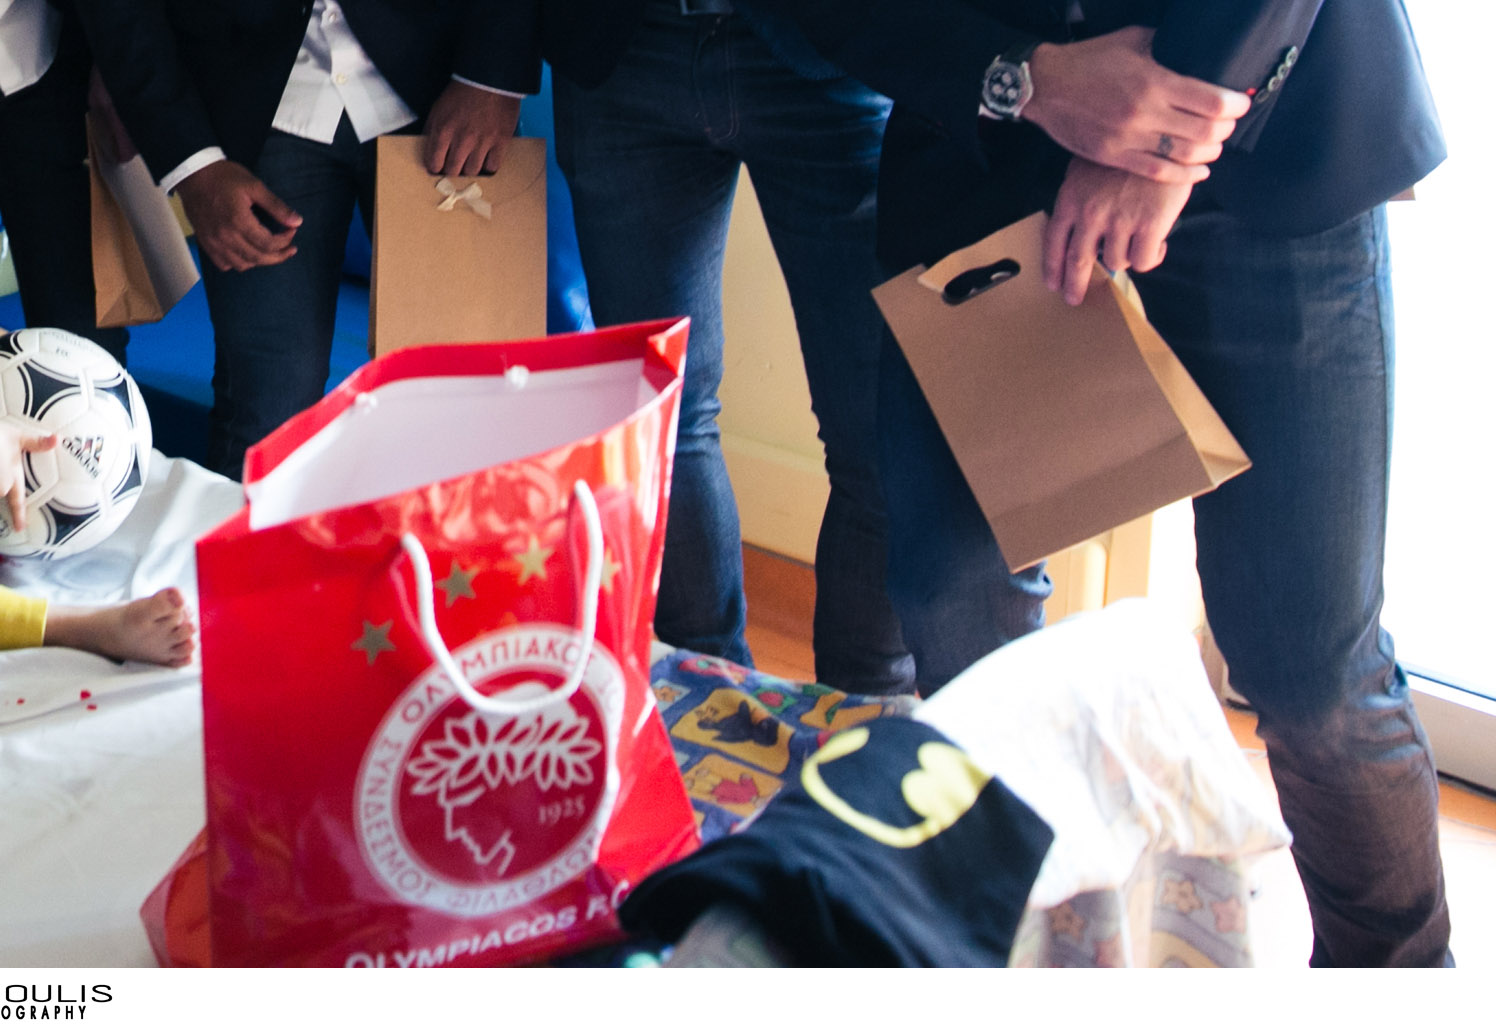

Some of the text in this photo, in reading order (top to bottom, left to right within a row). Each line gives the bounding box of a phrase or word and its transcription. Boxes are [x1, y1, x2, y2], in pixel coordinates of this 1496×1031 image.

[62, 438, 100, 479] adidas
[402, 637, 596, 724] ΟΛΜΠΙΑΚΟ
[539, 796, 586, 825] 1925
[344, 906, 577, 967] OLYMPIACOS
